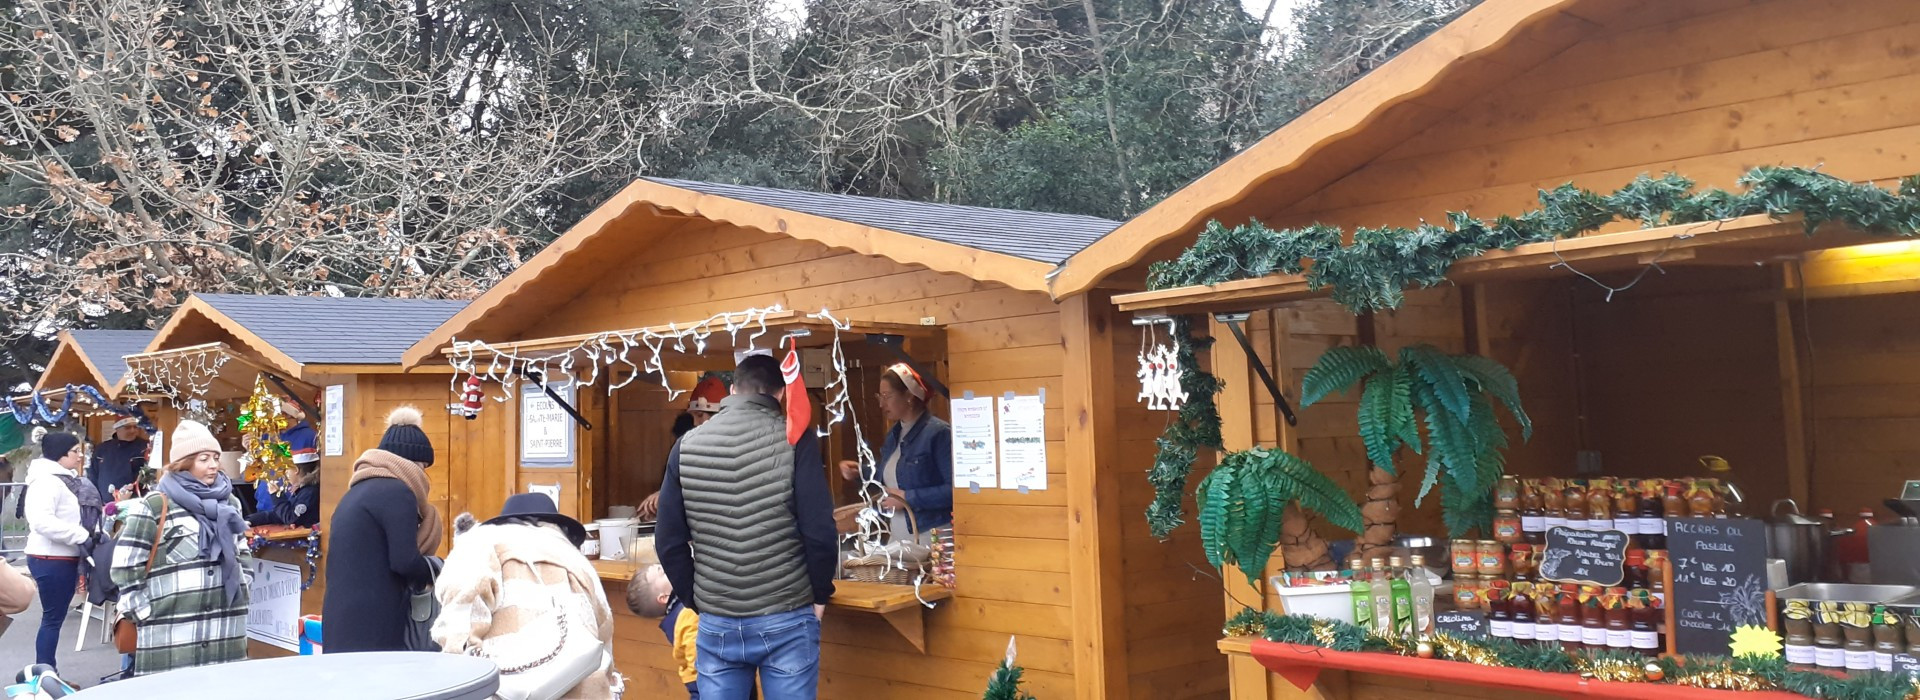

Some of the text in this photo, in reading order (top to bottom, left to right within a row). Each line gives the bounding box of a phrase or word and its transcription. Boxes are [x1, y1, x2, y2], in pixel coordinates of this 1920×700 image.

[529, 413, 563, 423] SATE-MARIE
[1675, 522, 1719, 535] ACCRAS
[1721, 563, 1736, 572] 10
[1722, 577, 1737, 587] 20
